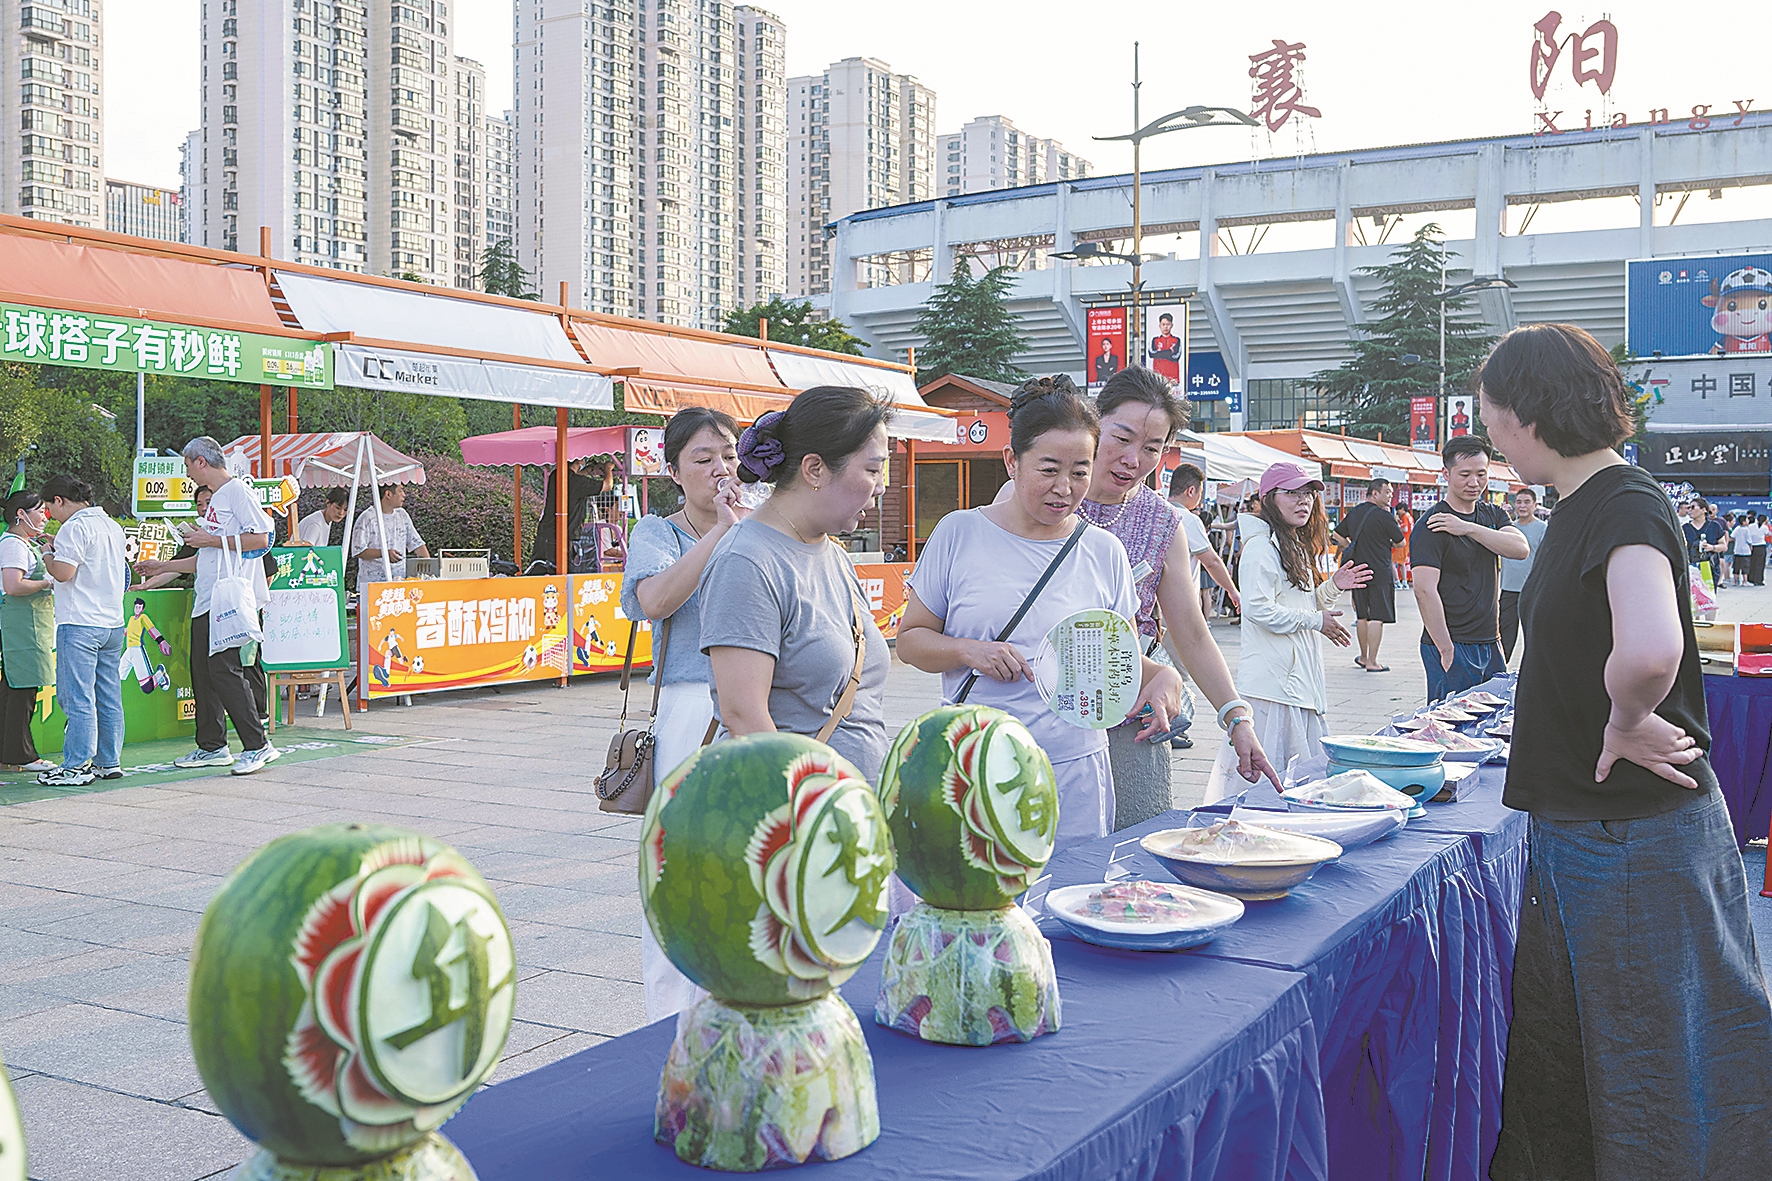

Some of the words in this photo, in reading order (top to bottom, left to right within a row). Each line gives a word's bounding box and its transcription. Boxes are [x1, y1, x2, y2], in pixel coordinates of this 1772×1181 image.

[0, 310, 243, 377] 球搭子有秒鲜
[395, 370, 438, 386] Market
[1192, 373, 1221, 388] 中心
[1692, 372, 1772, 399] 中国
[1665, 444, 1730, 465] 正山堂
[138, 462, 174, 475] 瞬时锁鲜
[124, 523, 166, 541] 一起过
[416, 597, 536, 649] 香酥鸡柳
[1107, 634, 1121, 704] 草本中药头疗
[176, 687, 194, 698] 瞬时
[183, 702, 196, 714] 0.0
[1080, 695, 1089, 716] 39.9
